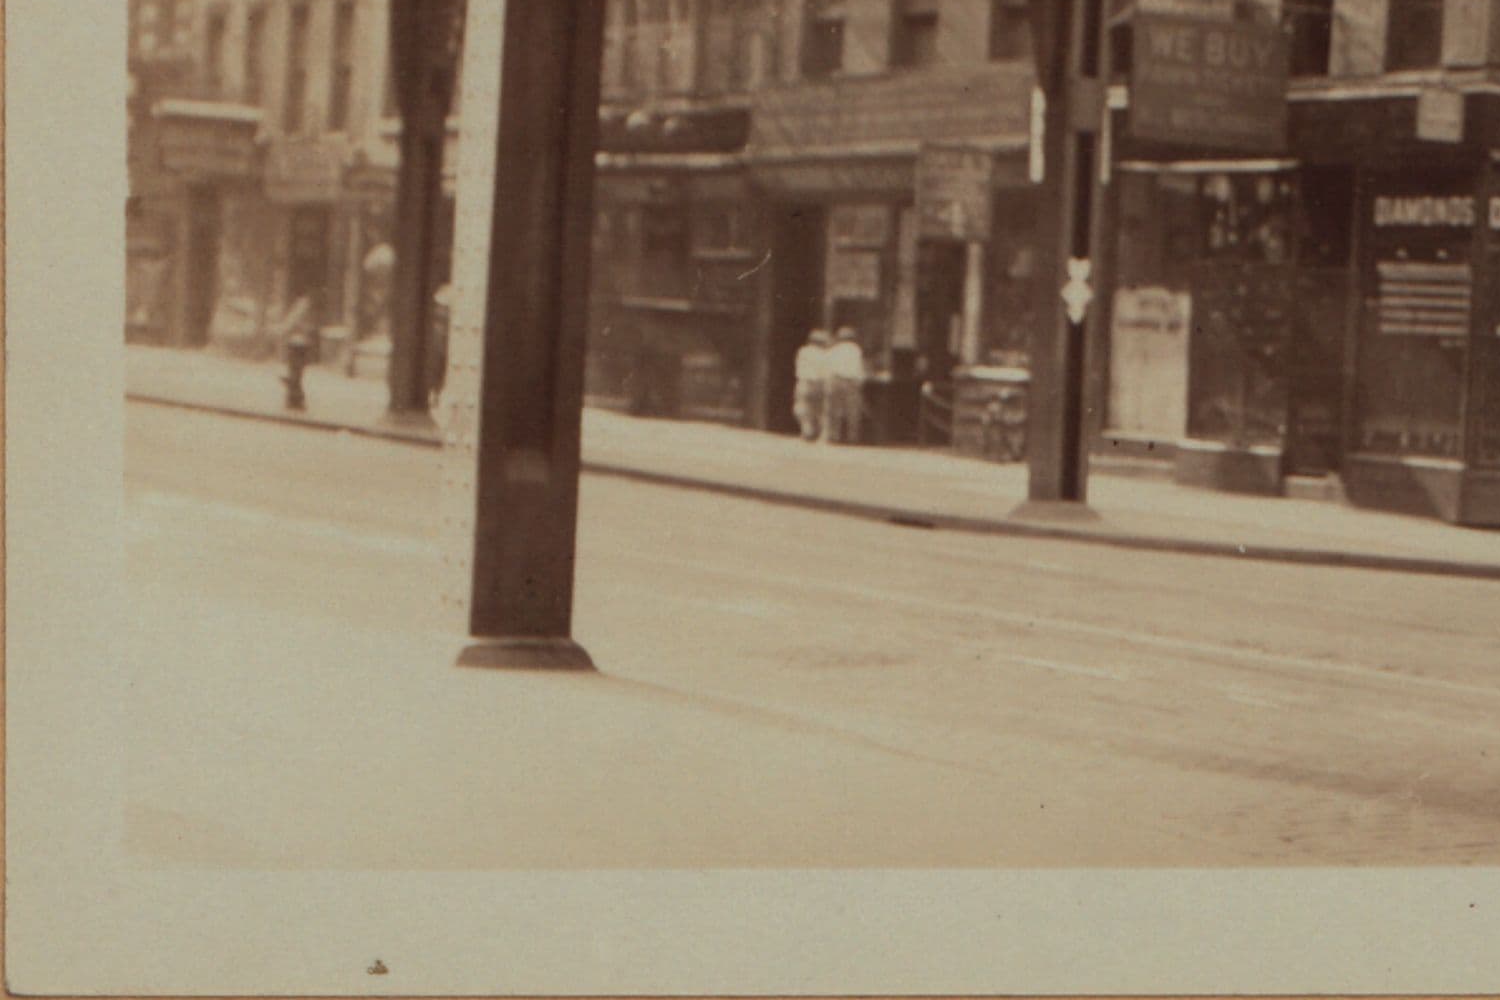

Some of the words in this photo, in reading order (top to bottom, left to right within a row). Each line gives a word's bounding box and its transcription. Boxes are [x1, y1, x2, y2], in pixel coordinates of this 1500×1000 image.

[1150, 25, 1192, 63] WE
[1206, 30, 1273, 69] BUY
[1375, 195, 1475, 228] DIAMONDS
